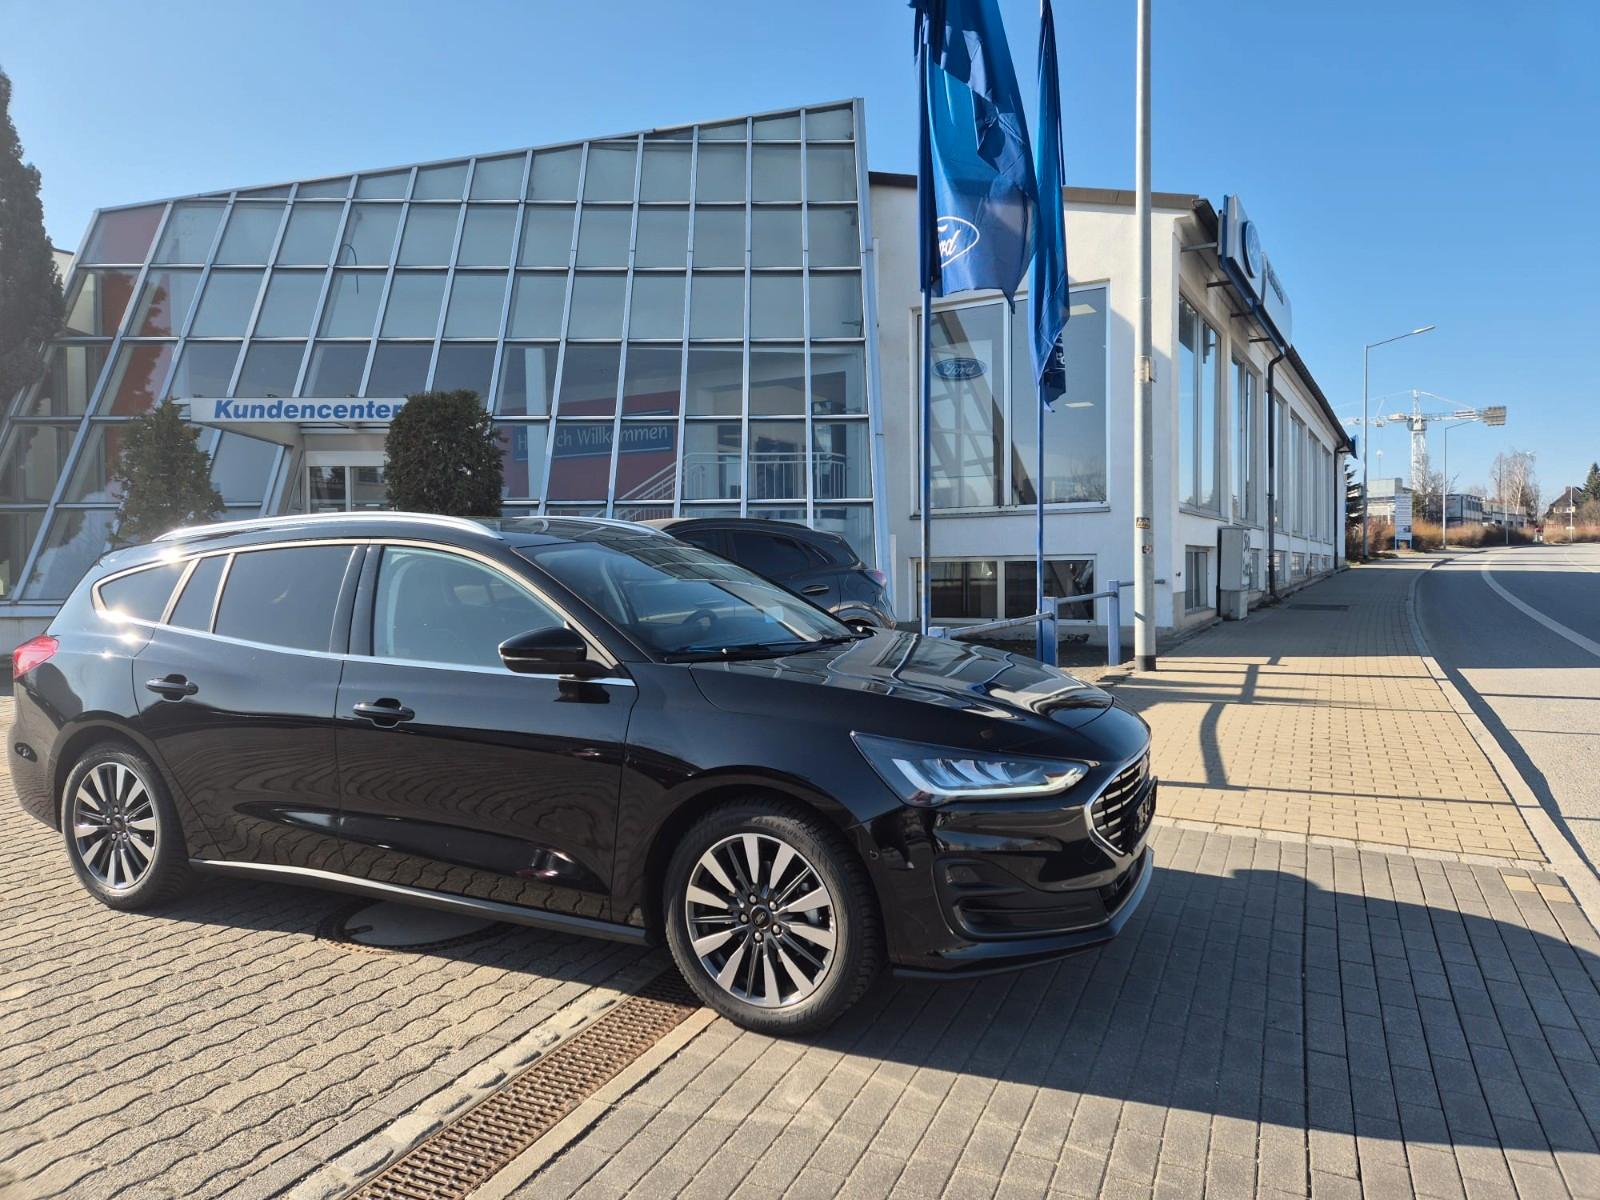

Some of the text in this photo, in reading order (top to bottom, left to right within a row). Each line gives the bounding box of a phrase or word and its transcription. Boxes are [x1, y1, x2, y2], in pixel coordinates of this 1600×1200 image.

[943, 361, 977, 376] Ford
[214, 400, 403, 419] Kundencenter
[576, 425, 668, 446] Willkmmen
